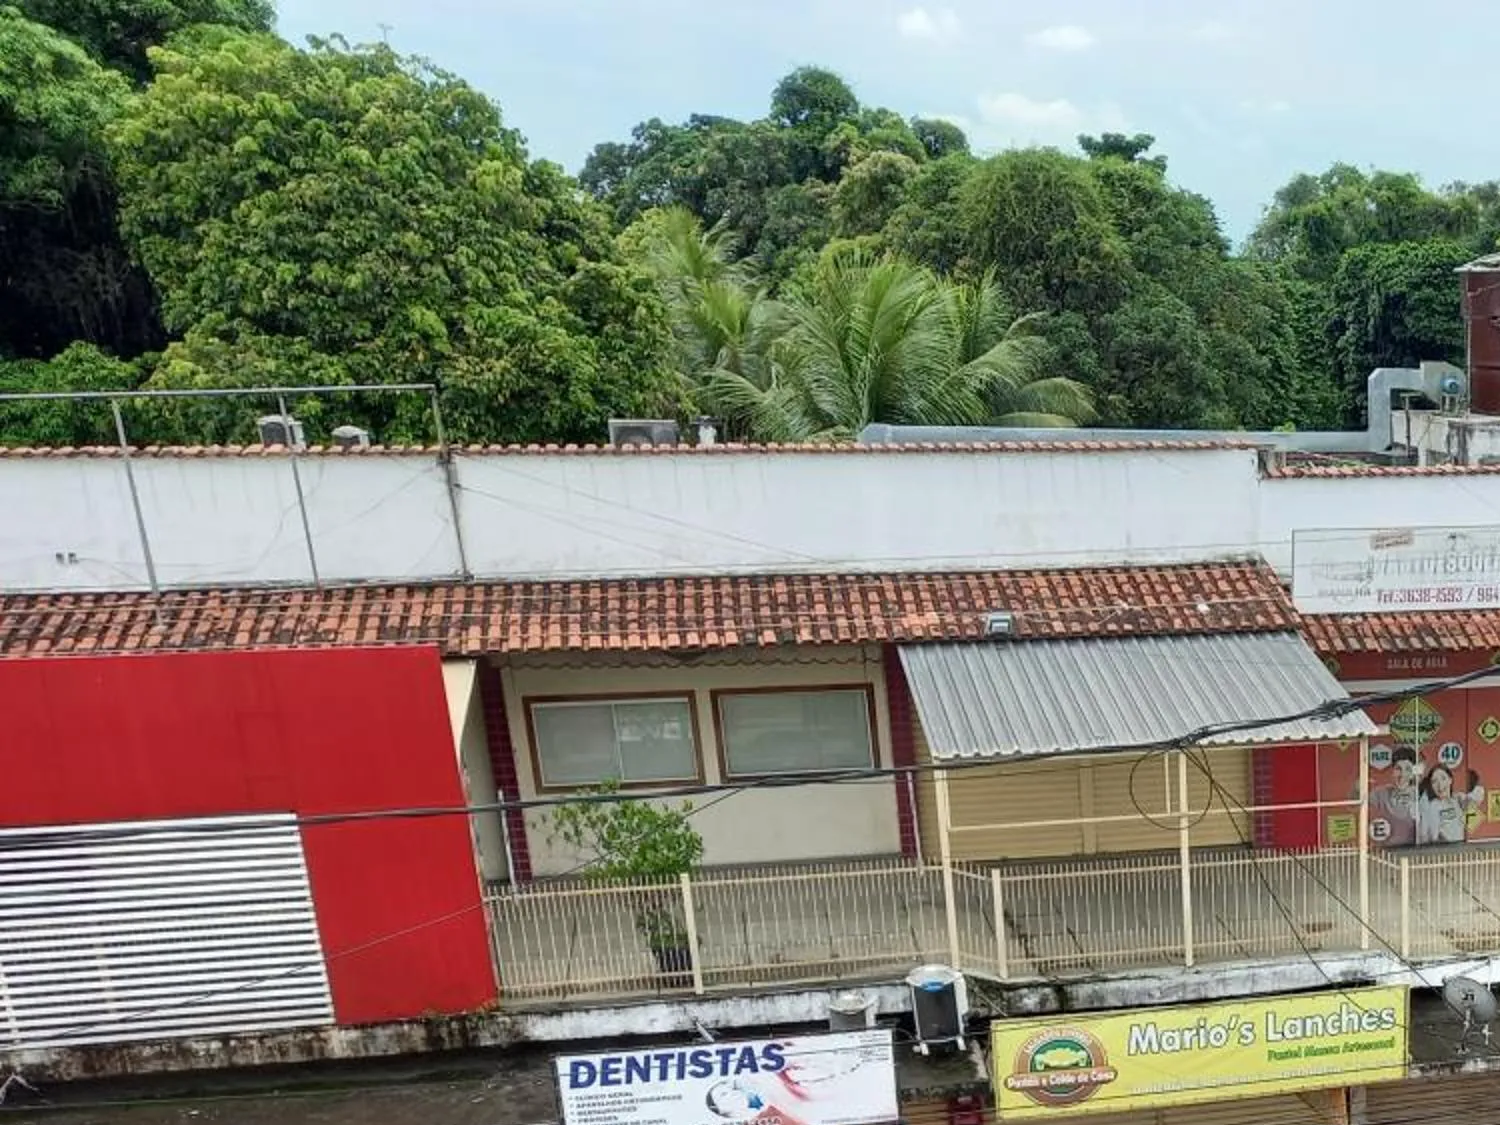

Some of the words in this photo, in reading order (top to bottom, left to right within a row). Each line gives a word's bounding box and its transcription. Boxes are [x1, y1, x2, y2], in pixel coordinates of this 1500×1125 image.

[1128, 1014, 1256, 1056] Mario's
[1265, 1002, 1397, 1042] Lanches
[569, 1043, 786, 1089] DENTISTAS
